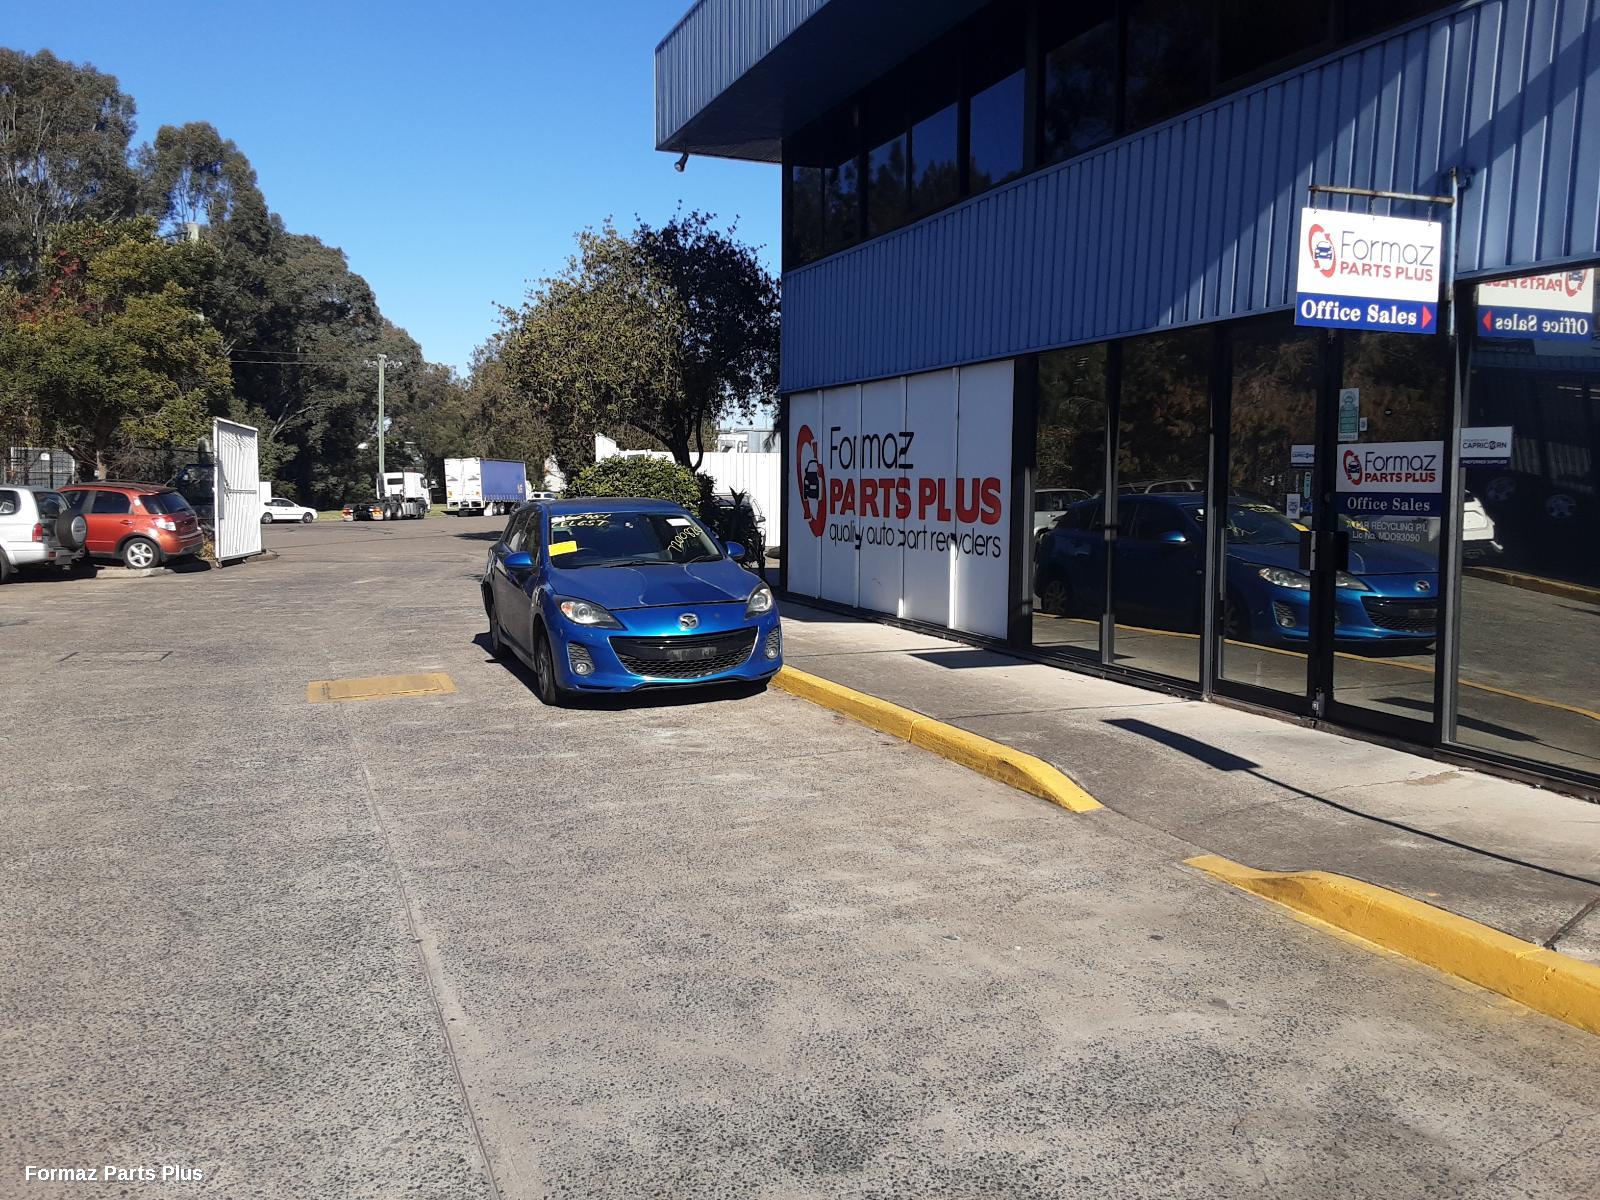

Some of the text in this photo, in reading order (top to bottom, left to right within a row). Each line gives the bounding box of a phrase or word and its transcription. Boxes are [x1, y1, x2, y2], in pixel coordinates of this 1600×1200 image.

[1341, 230, 1434, 267] Formaz
[1340, 261, 1433, 281] PARTS PLUS
[1301, 300, 1417, 325] Office Sales
[830, 426, 914, 469] Formaz
[1365, 452, 1437, 471] Formaz
[1364, 472, 1436, 482] PARTS PLUS
[829, 477, 1001, 525] PARTS PLUS
[1347, 497, 1430, 511] Office Sales
[1371, 521, 1413, 532] RECYCLING
[867, 521, 894, 546] auto
[931, 527, 1001, 560] recyclers
